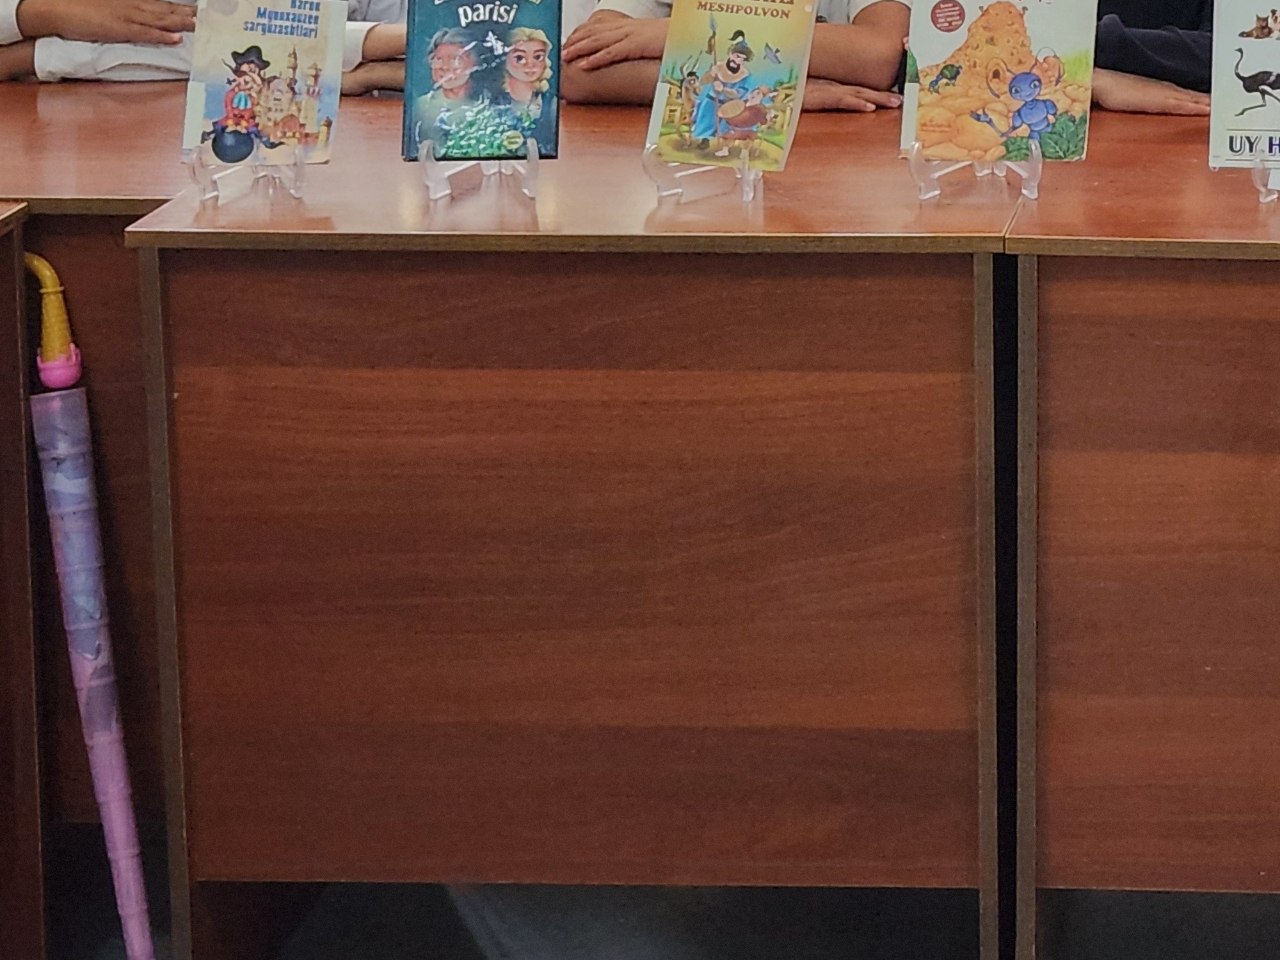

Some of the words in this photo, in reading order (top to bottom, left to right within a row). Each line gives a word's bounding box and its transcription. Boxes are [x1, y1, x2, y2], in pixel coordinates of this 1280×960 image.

[458, 0, 519, 27] parisi
[697, 1, 791, 20] MESHPOLVON
[243, 20, 318, 39] sarguzashtlari
[1229, 135, 1262, 154] UY
